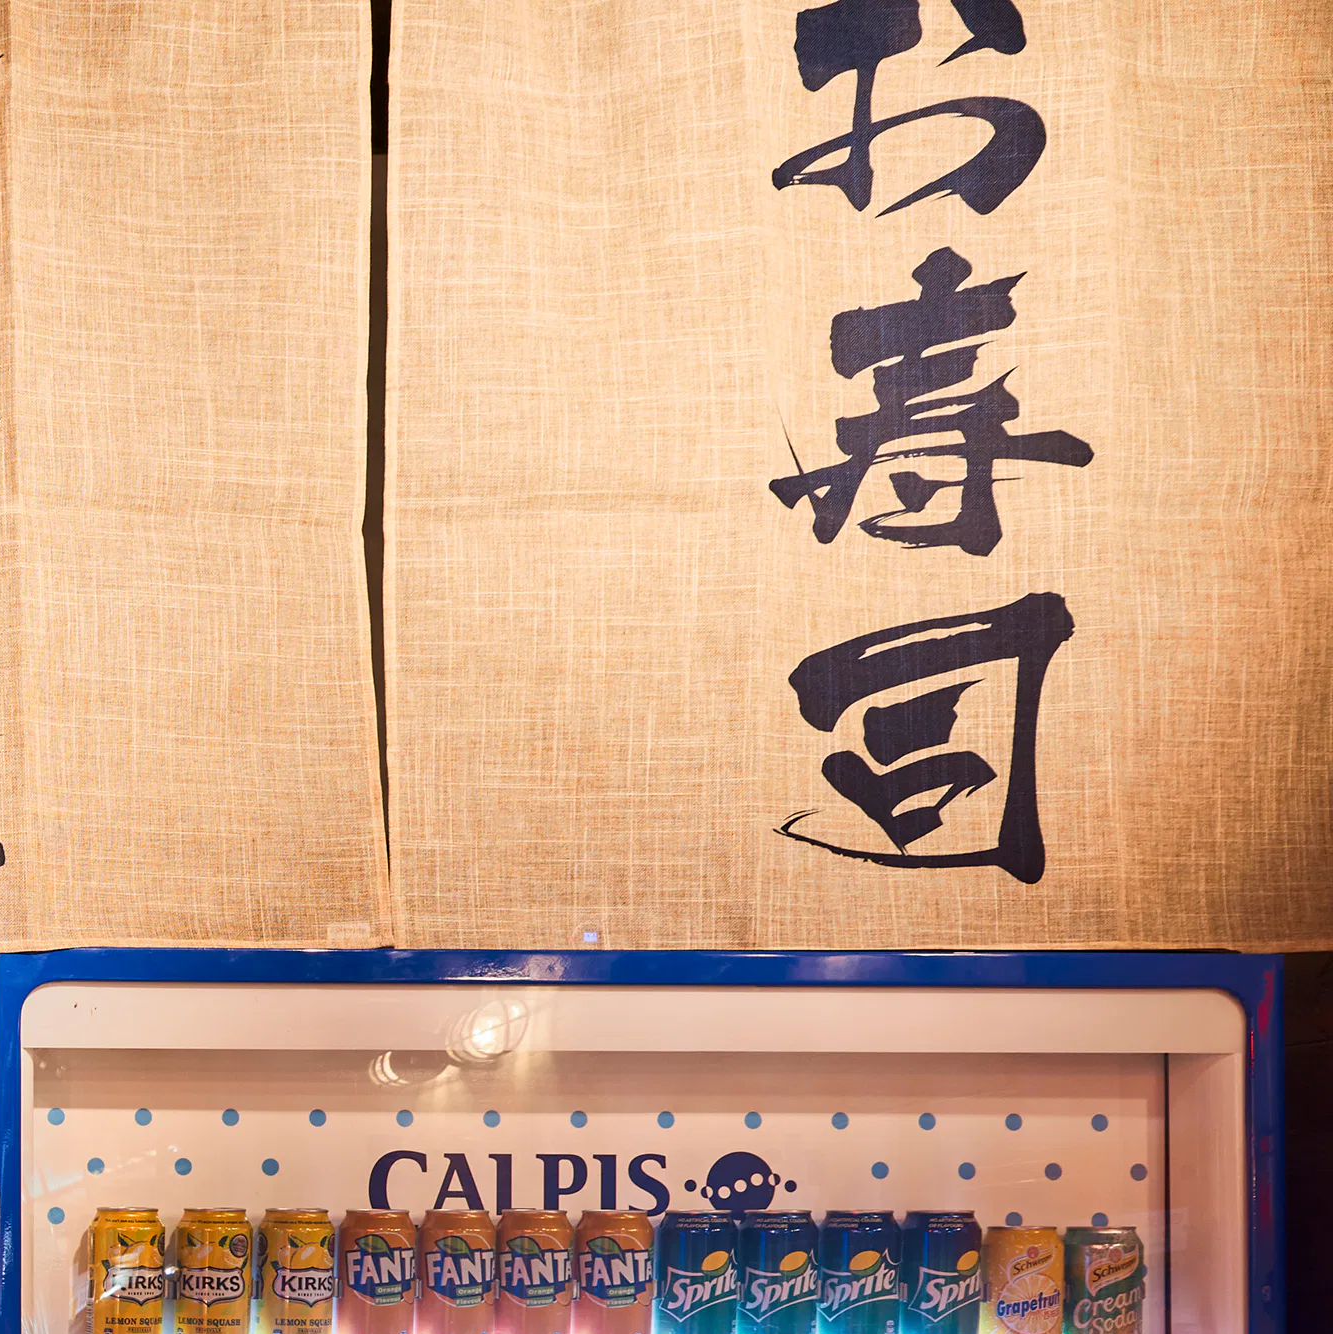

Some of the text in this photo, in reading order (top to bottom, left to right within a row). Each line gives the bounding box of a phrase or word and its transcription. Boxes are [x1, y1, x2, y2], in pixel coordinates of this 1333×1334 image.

[769, 0, 1095, 885] お寿司
[368, 1150, 671, 1217] CALPIS
[183, 1275, 240, 1292] KIRKS
[281, 1275, 332, 1292] KIRKS
[824, 1262, 896, 1311] Sprite
[996, 1288, 1061, 1319] Grapefruit
[177, 1317, 241, 1327] LEMON SQUASH
